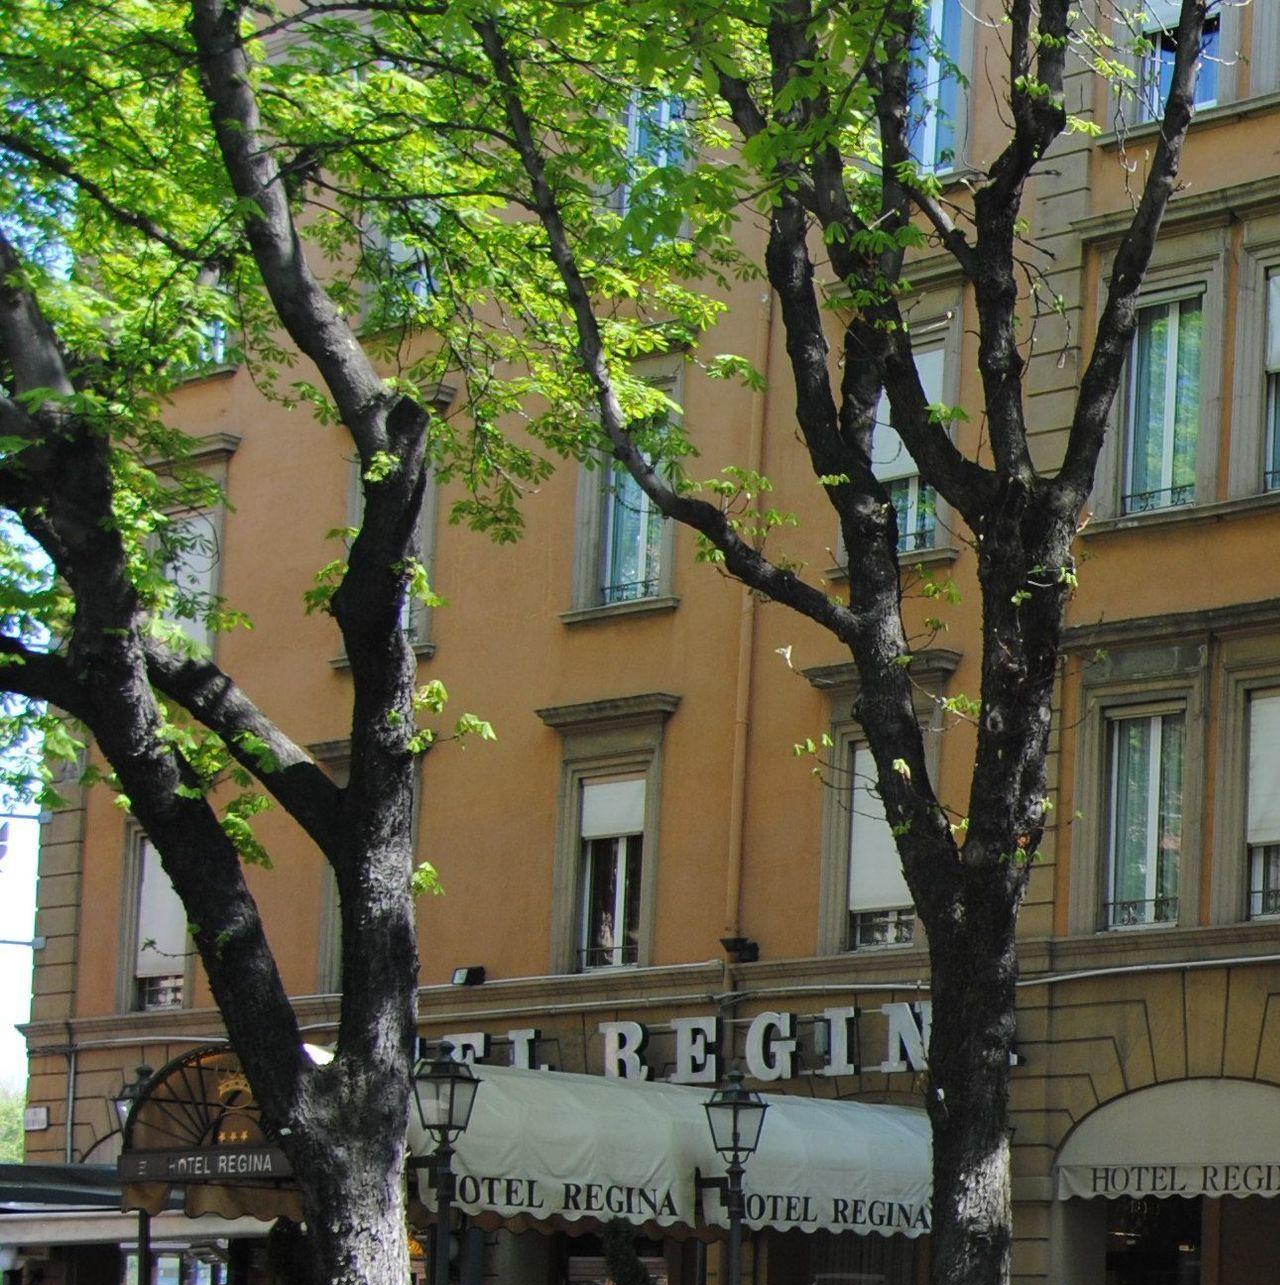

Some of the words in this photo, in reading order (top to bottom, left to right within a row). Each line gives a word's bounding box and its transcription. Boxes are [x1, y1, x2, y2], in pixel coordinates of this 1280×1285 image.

[598, 1001, 1018, 1084] REGIN
[218, 1154, 272, 1174] REGINA
[1091, 1166, 1186, 1193] HOTEL
[562, 1182, 678, 1217] REGINA
[832, 1197, 932, 1231] REGINA
